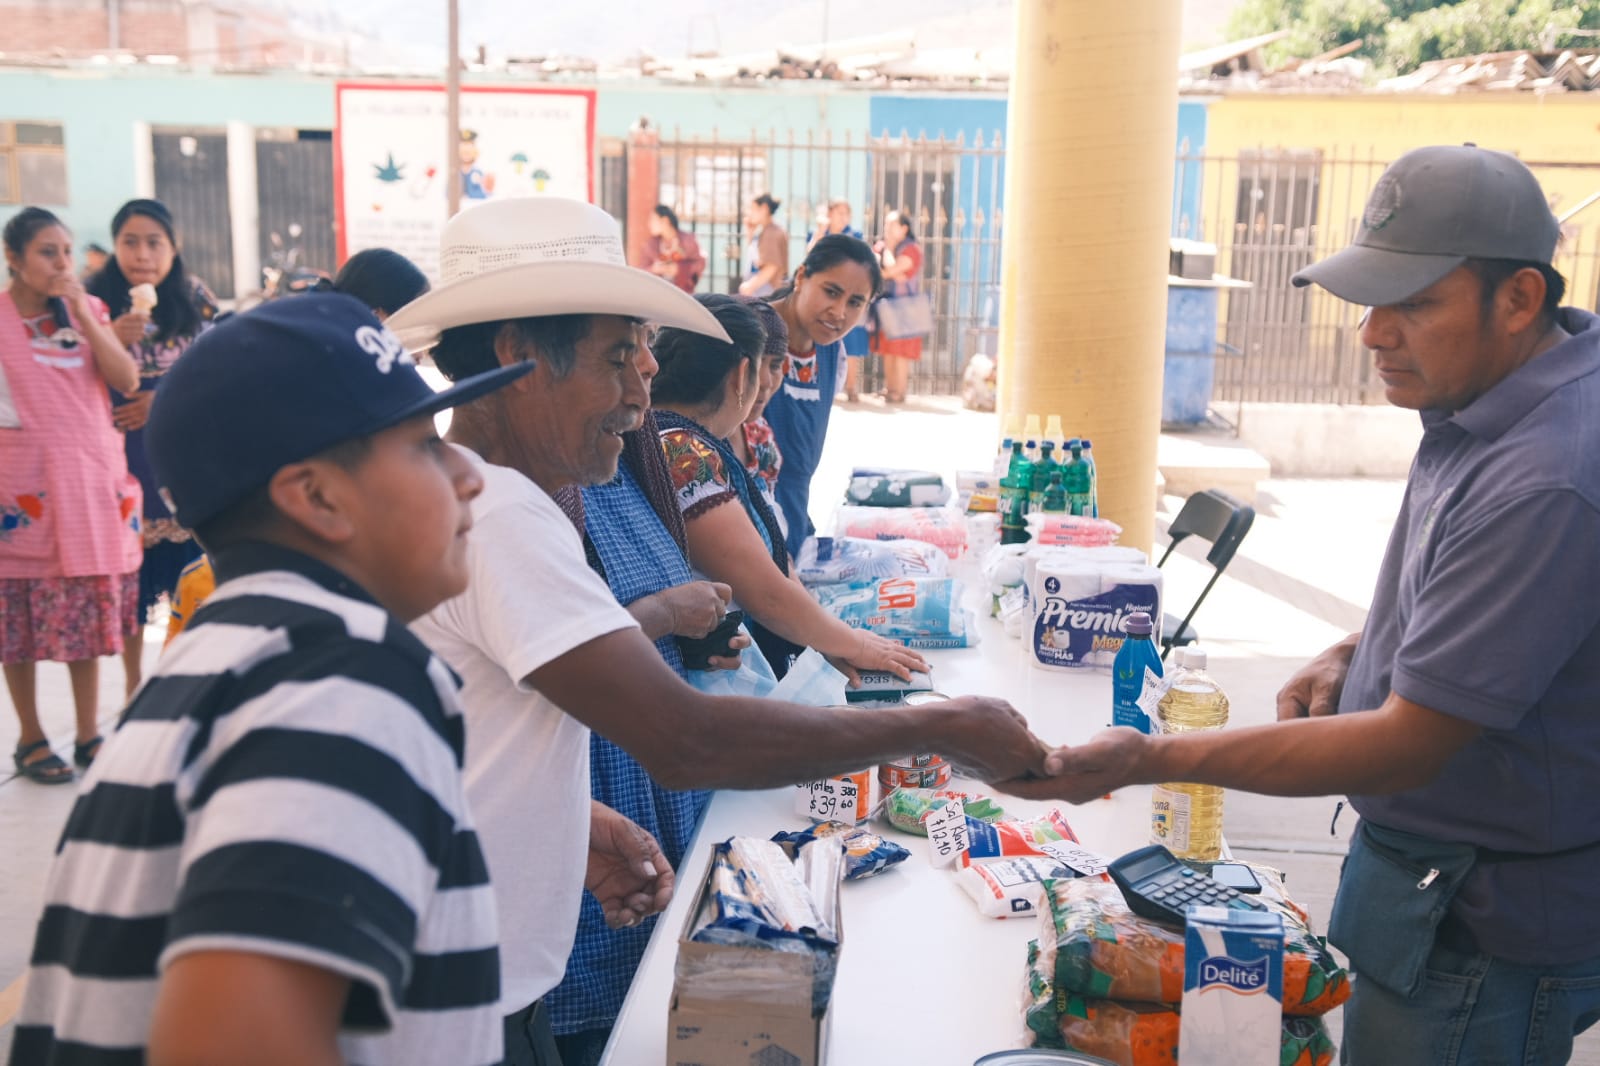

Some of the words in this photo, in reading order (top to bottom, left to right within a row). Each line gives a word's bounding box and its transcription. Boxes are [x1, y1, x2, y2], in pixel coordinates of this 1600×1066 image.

[1047, 578, 1057, 590] 4
[946, 801, 963, 821] Sal
[930, 818, 951, 856] $12.40
[1204, 964, 1260, 986] Delité
